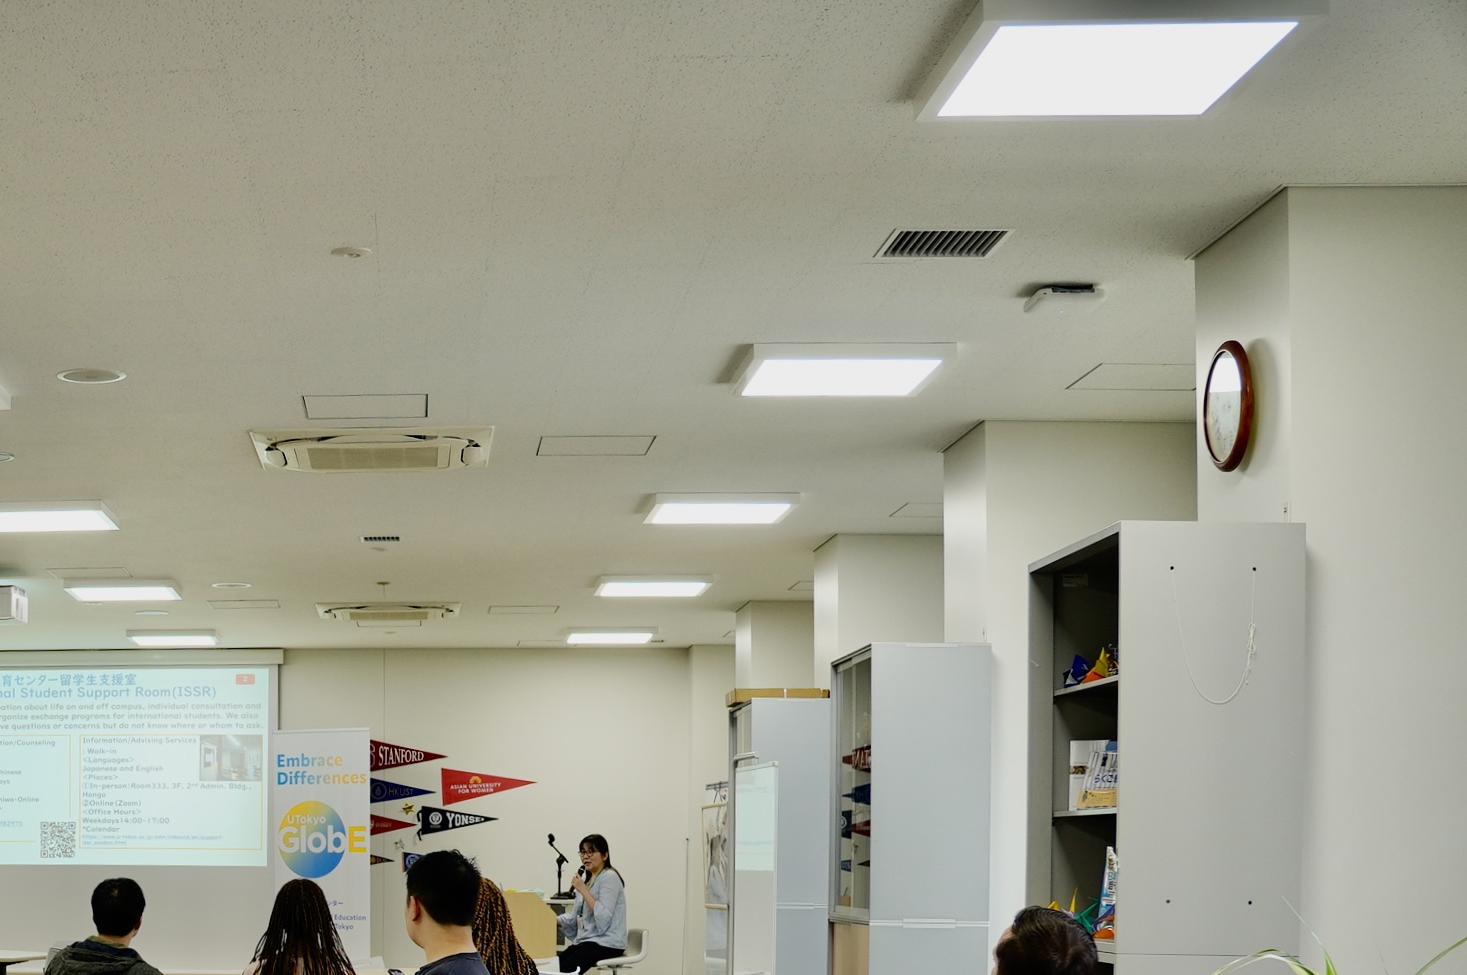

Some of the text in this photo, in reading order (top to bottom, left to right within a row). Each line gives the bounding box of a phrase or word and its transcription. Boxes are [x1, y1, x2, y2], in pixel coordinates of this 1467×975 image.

[20, 687, 73, 698] Student
[77, 686, 130, 699] Support
[135, 686, 216, 698] Room(ISSR)
[31, 713, 69, 722] exchange
[82, 736, 162, 745] Information/Advising
[278, 753, 342, 767] Embrace
[379, 745, 424, 766] STANFORD
[278, 770, 367, 785] Differences
[388, 787, 414, 796] HKUST
[287, 814, 326, 825] UTokyo
[278, 825, 367, 854] GlobE
